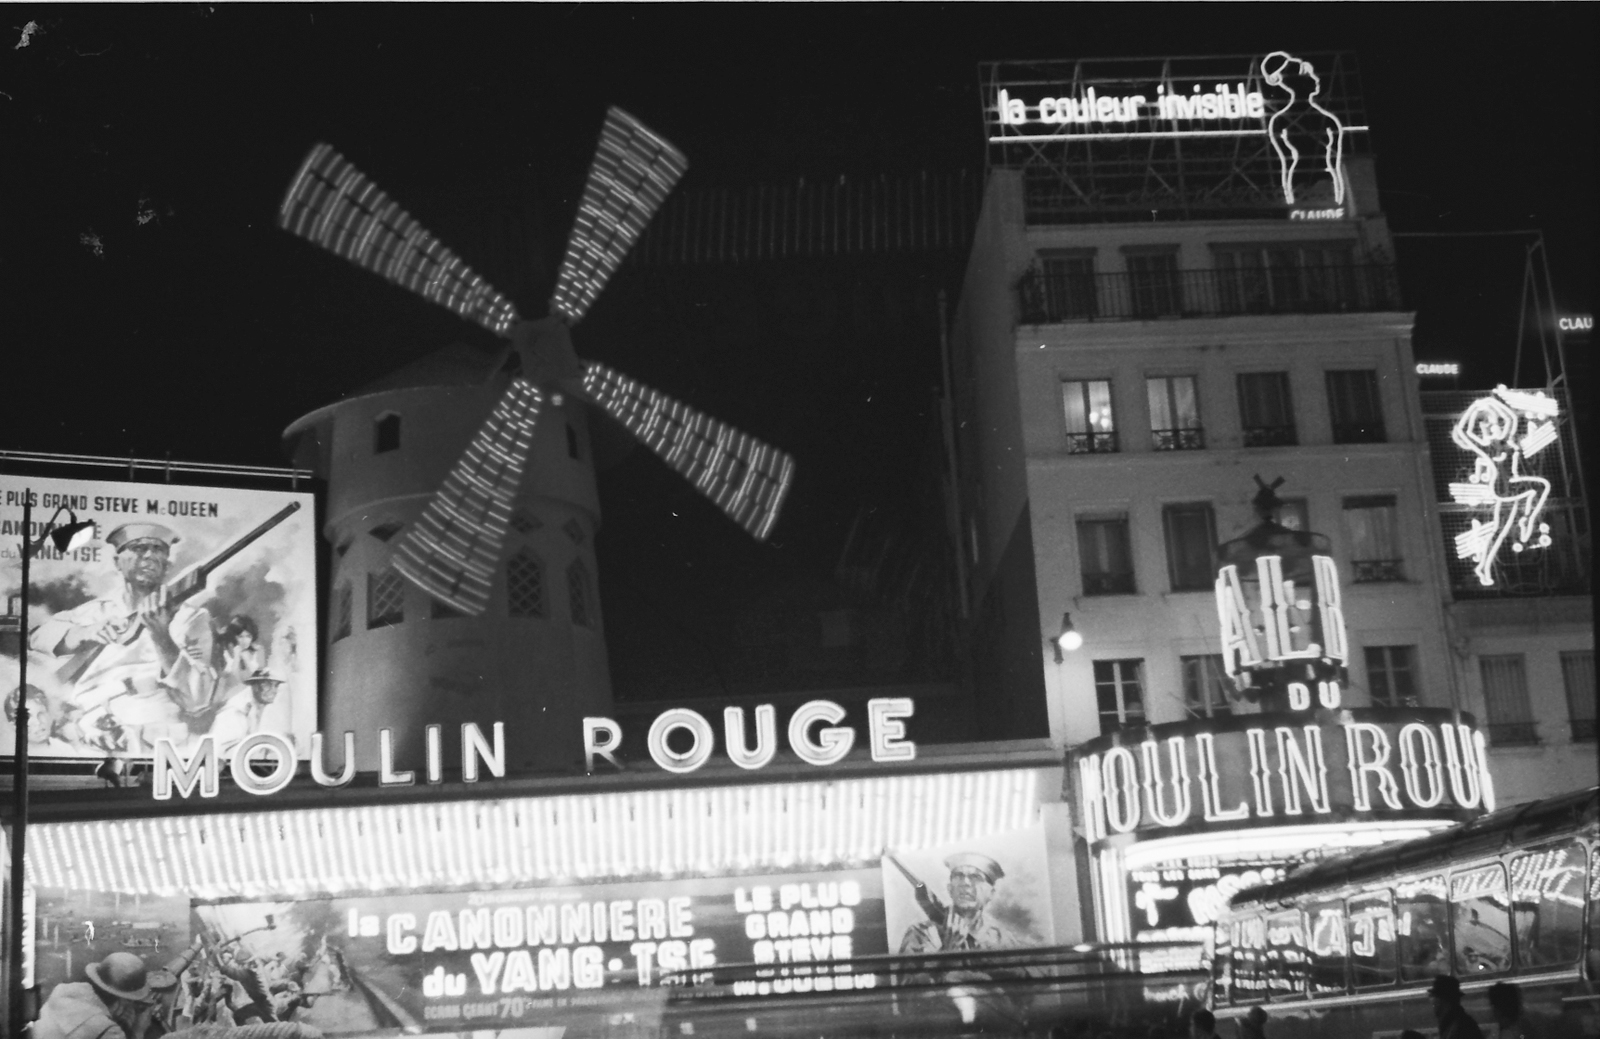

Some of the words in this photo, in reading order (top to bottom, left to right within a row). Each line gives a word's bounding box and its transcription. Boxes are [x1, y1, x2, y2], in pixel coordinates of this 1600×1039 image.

[998, 88, 1026, 125] la
[1039, 86, 1146, 124] couleur
[1157, 82, 1265, 120] invisible
[1415, 363, 1459, 375] CLAUDE
[42, 492, 88, 511] GRAND
[94, 495, 139, 513] STEVE
[1287, 681, 1342, 711] DU
[152, 720, 506, 801] MOULIN
[582, 697, 917, 776] ROUGE
[1079, 725, 1331, 843] MOULIN
[734, 885, 773, 913] LE
[780, 880, 861, 911] PLUS
[348, 907, 380, 937] la
[386, 896, 694, 955] CANONNIERE
[745, 907, 855, 939] GRAND
[753, 935, 853, 978] STEVE
[422, 965, 467, 998] du
